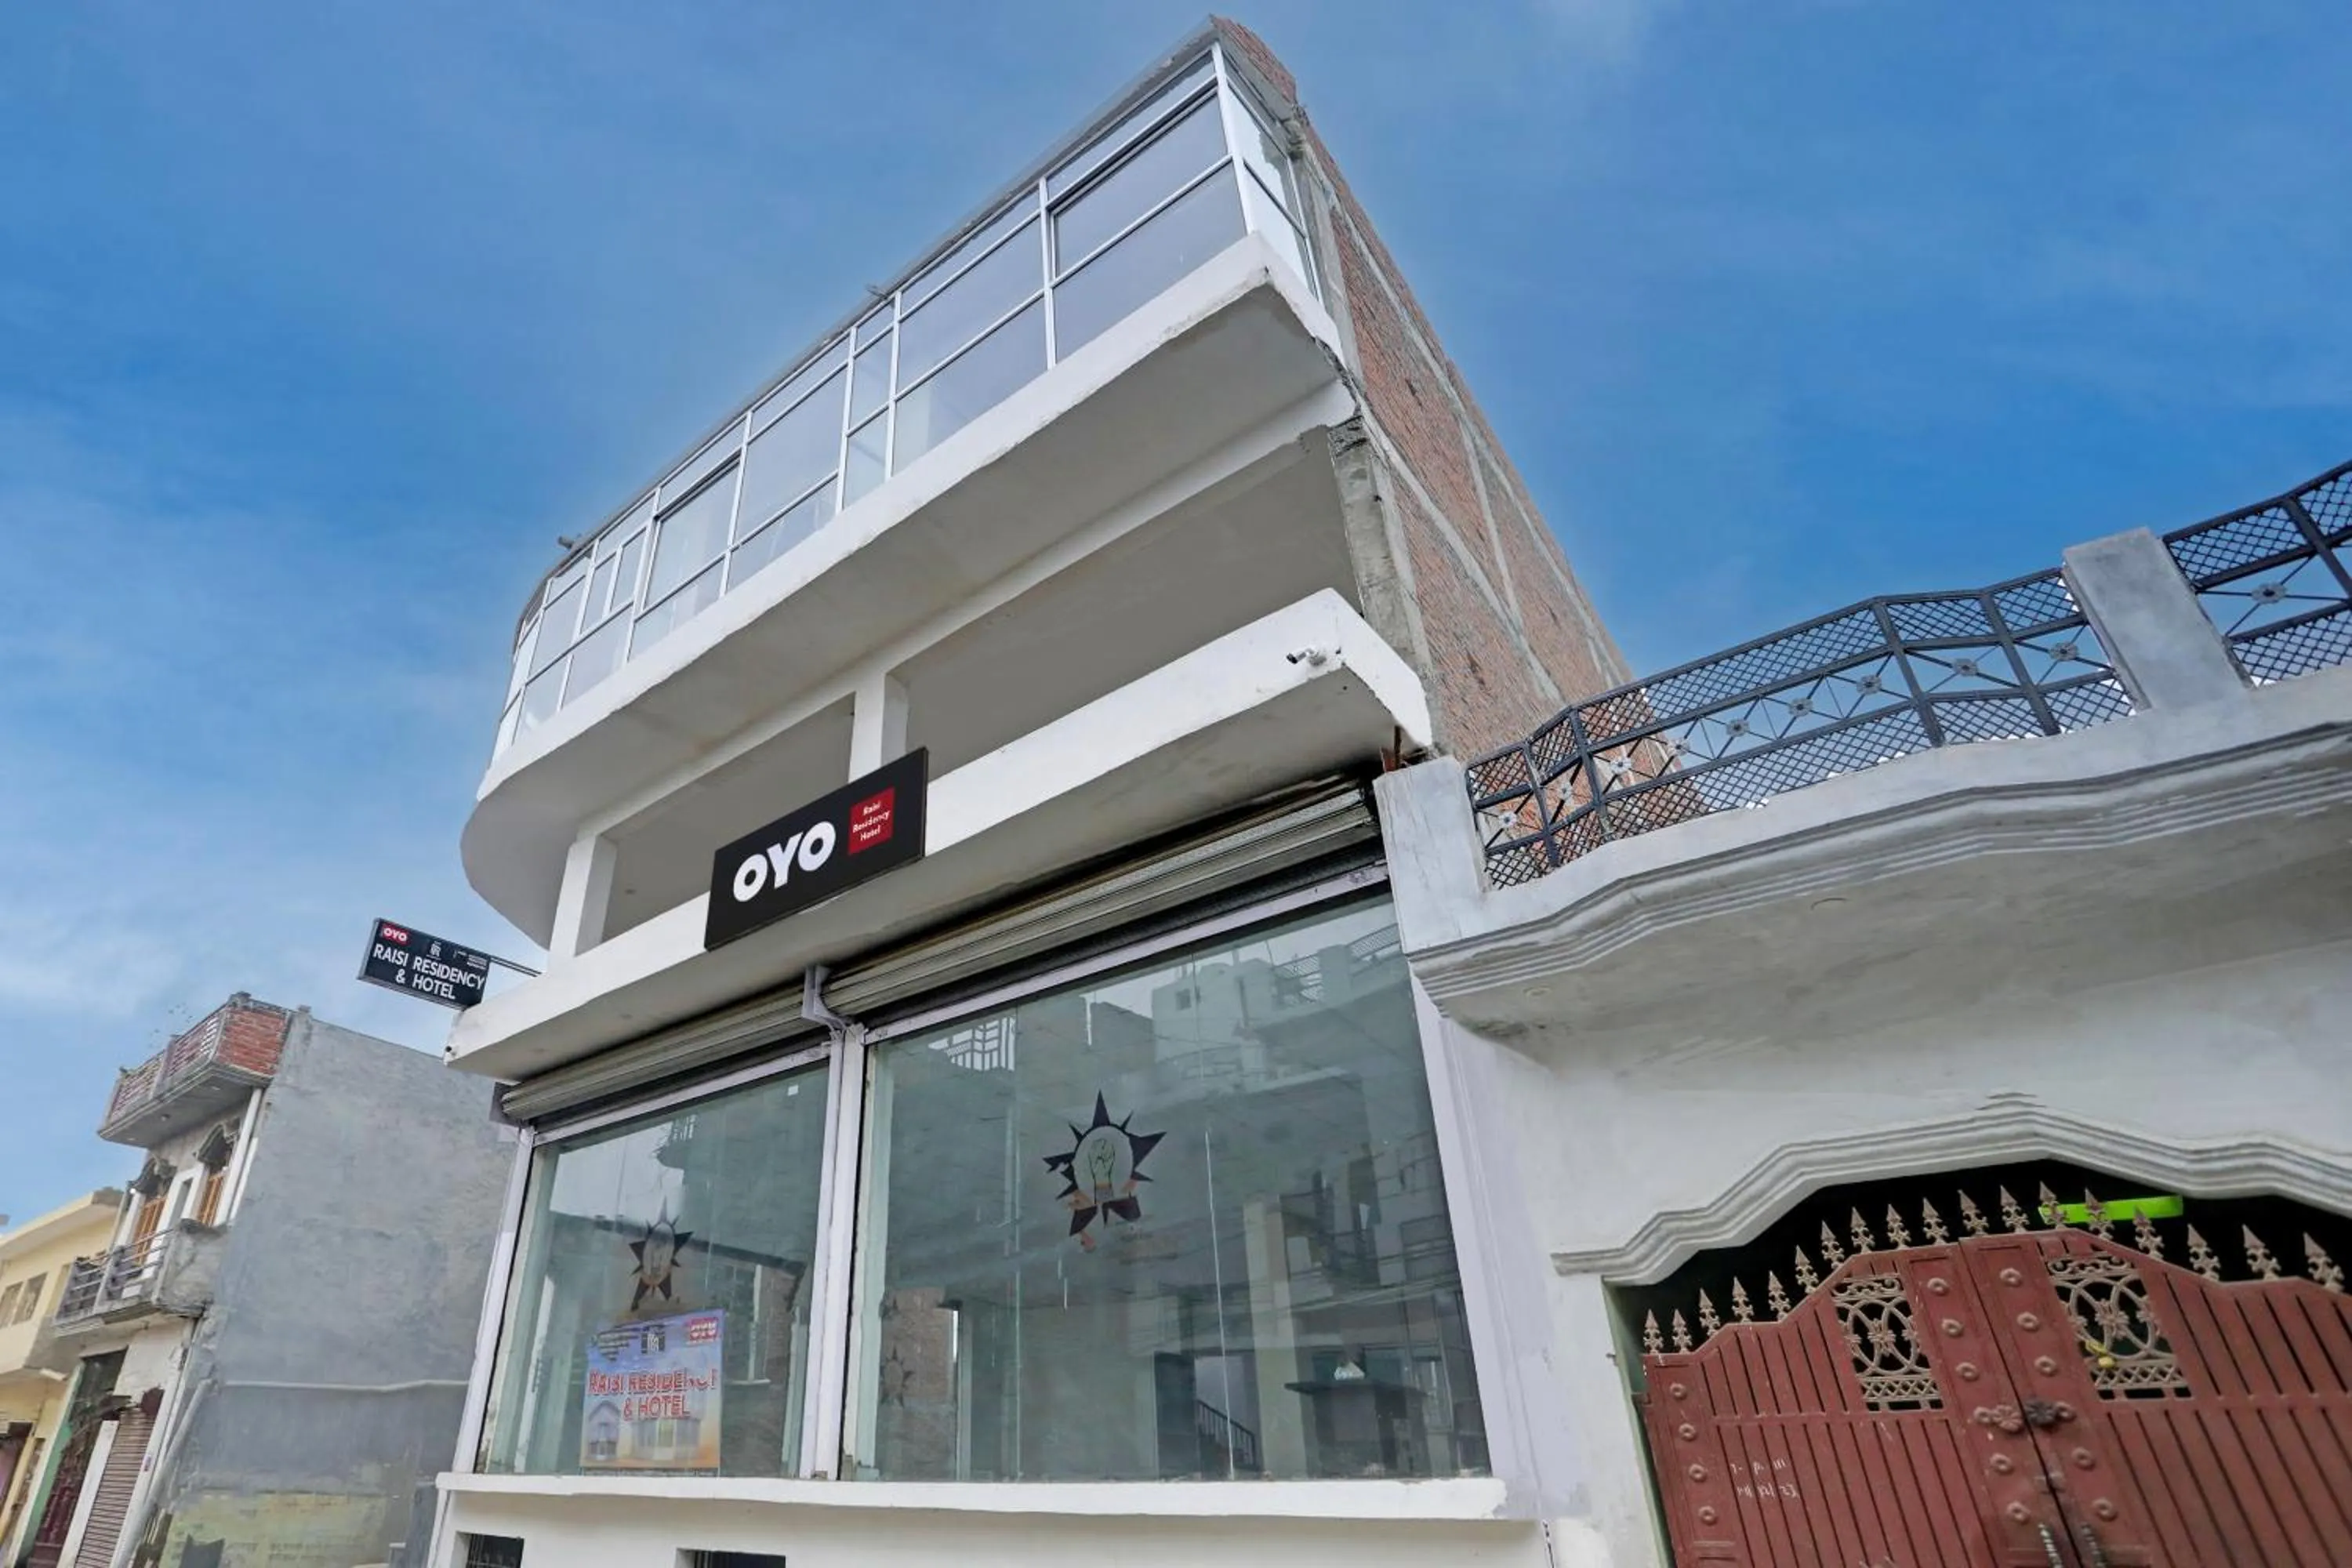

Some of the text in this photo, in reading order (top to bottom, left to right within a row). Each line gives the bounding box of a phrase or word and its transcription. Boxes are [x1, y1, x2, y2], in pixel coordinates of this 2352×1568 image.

[853, 810, 890, 833] Residency
[860, 825, 880, 841] Hotel
[733, 821, 836, 902] OYO
[383, 927, 407, 942] OYO
[372, 943, 408, 967] RAISI
[412, 956, 485, 990] RESIDENCY
[394, 969, 456, 1000] & HOTEL
[638, 1395, 690, 1421] HOTEL
